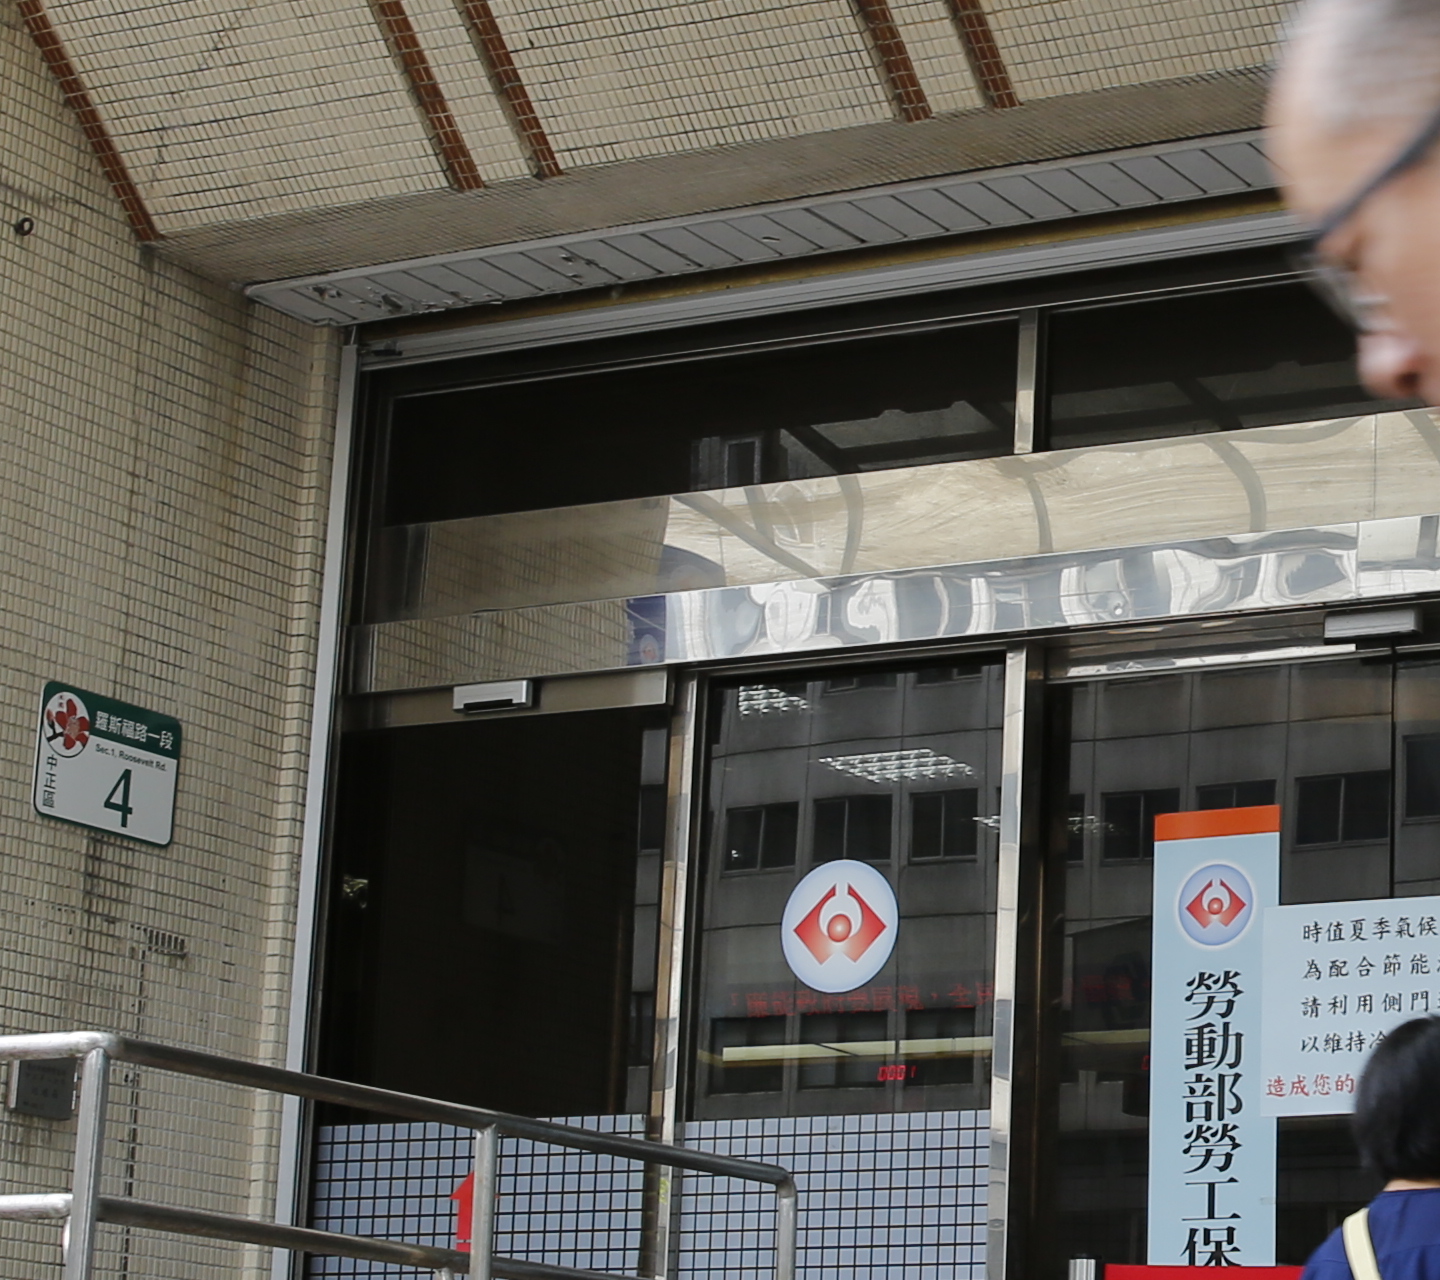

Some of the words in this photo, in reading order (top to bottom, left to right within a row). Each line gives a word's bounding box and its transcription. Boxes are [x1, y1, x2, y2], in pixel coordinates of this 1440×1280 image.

[95, 710, 174, 751] 羅斯福路一段
[119, 750, 154, 769] Roosevelt
[103, 768, 133, 828] 4
[1266, 1074, 1356, 1097] 造成您的
